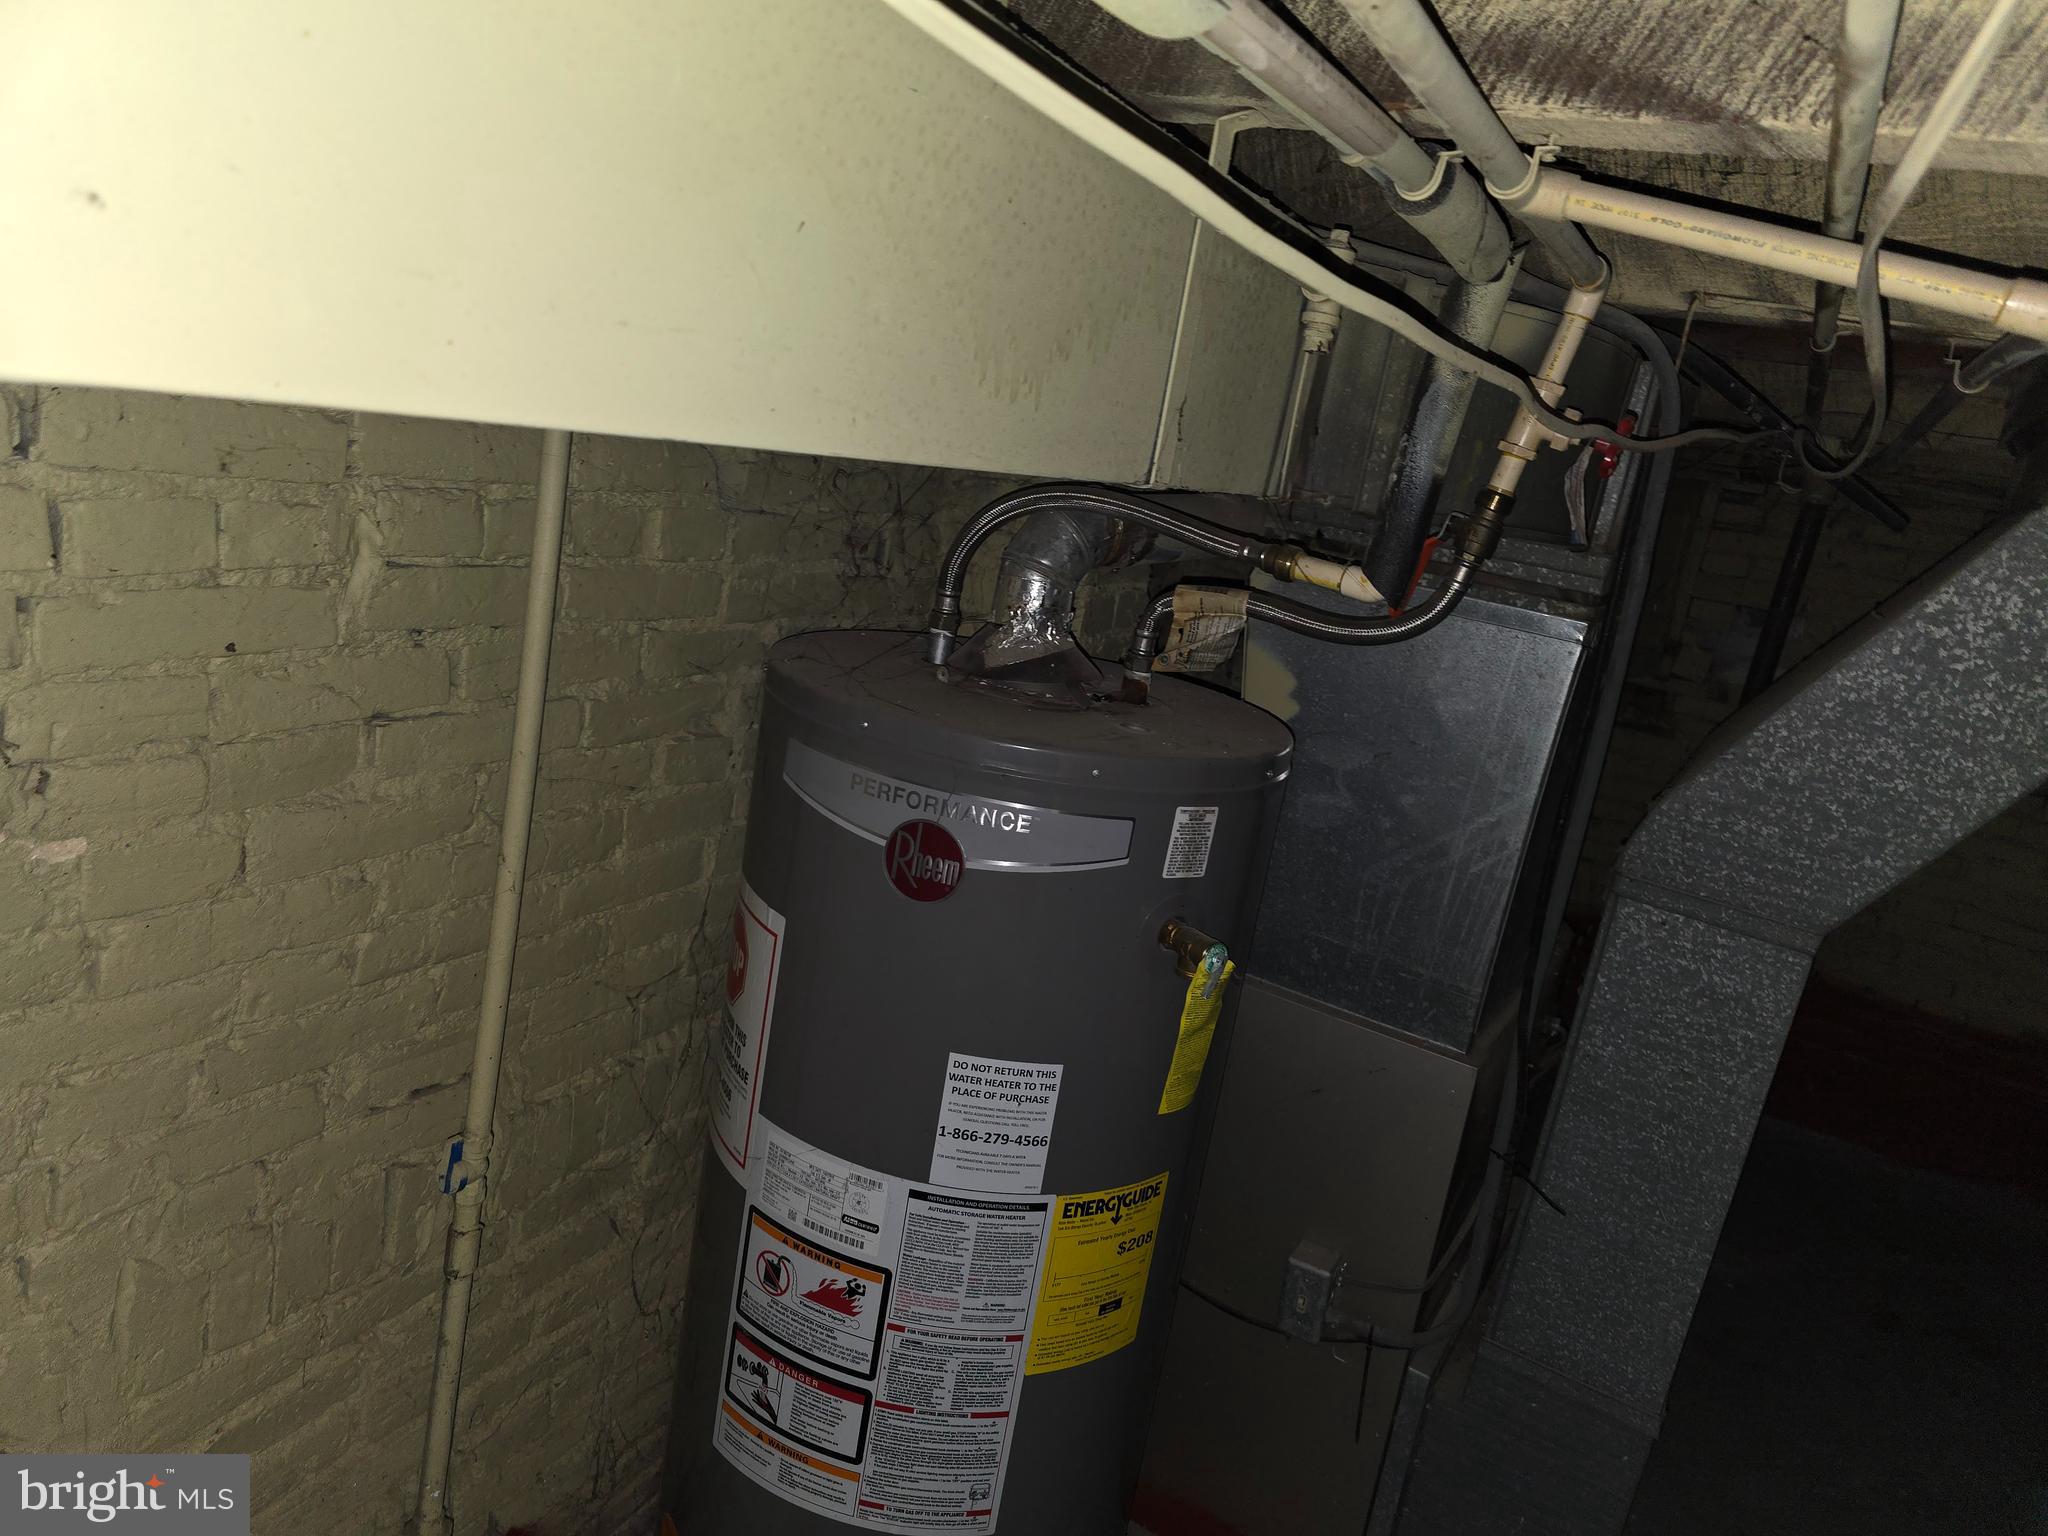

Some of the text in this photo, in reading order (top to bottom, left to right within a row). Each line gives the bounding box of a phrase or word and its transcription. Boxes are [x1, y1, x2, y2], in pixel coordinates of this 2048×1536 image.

[850, 772, 1032, 834] PERFORMANCE
[892, 822, 960, 888] Rheem
[953, 1060, 1057, 1078] DO NOT RETURN THIS
[948, 1072, 1057, 1091] WATER HEATER TO THE
[952, 1086, 1049, 1104] PLACE OF PURCHASE
[938, 1125, 1048, 1147] 1-866-279-4566
[928, 1195, 964, 1206] INSTALLATION
[978, 1202, 1008, 1210] OPERATION
[928, 1206, 960, 1216] AUTOMATIC
[1062, 1181, 1162, 1220] ENERGYGUIDE
[792, 1240, 840, 1269] WARNING
[1117, 1230, 1153, 1255] $208
[779, 1303, 789, 1312] AND
[789, 1307, 814, 1325] EXPLOSION
[815, 1320, 835, 1334] HAZARD
[799, 1300, 846, 1324] Flammable Vapors
[930, 1331, 947, 1339] SAFETY
[779, 1363, 818, 1388] DANGER
[768, 1438, 808, 1464] WARNING
